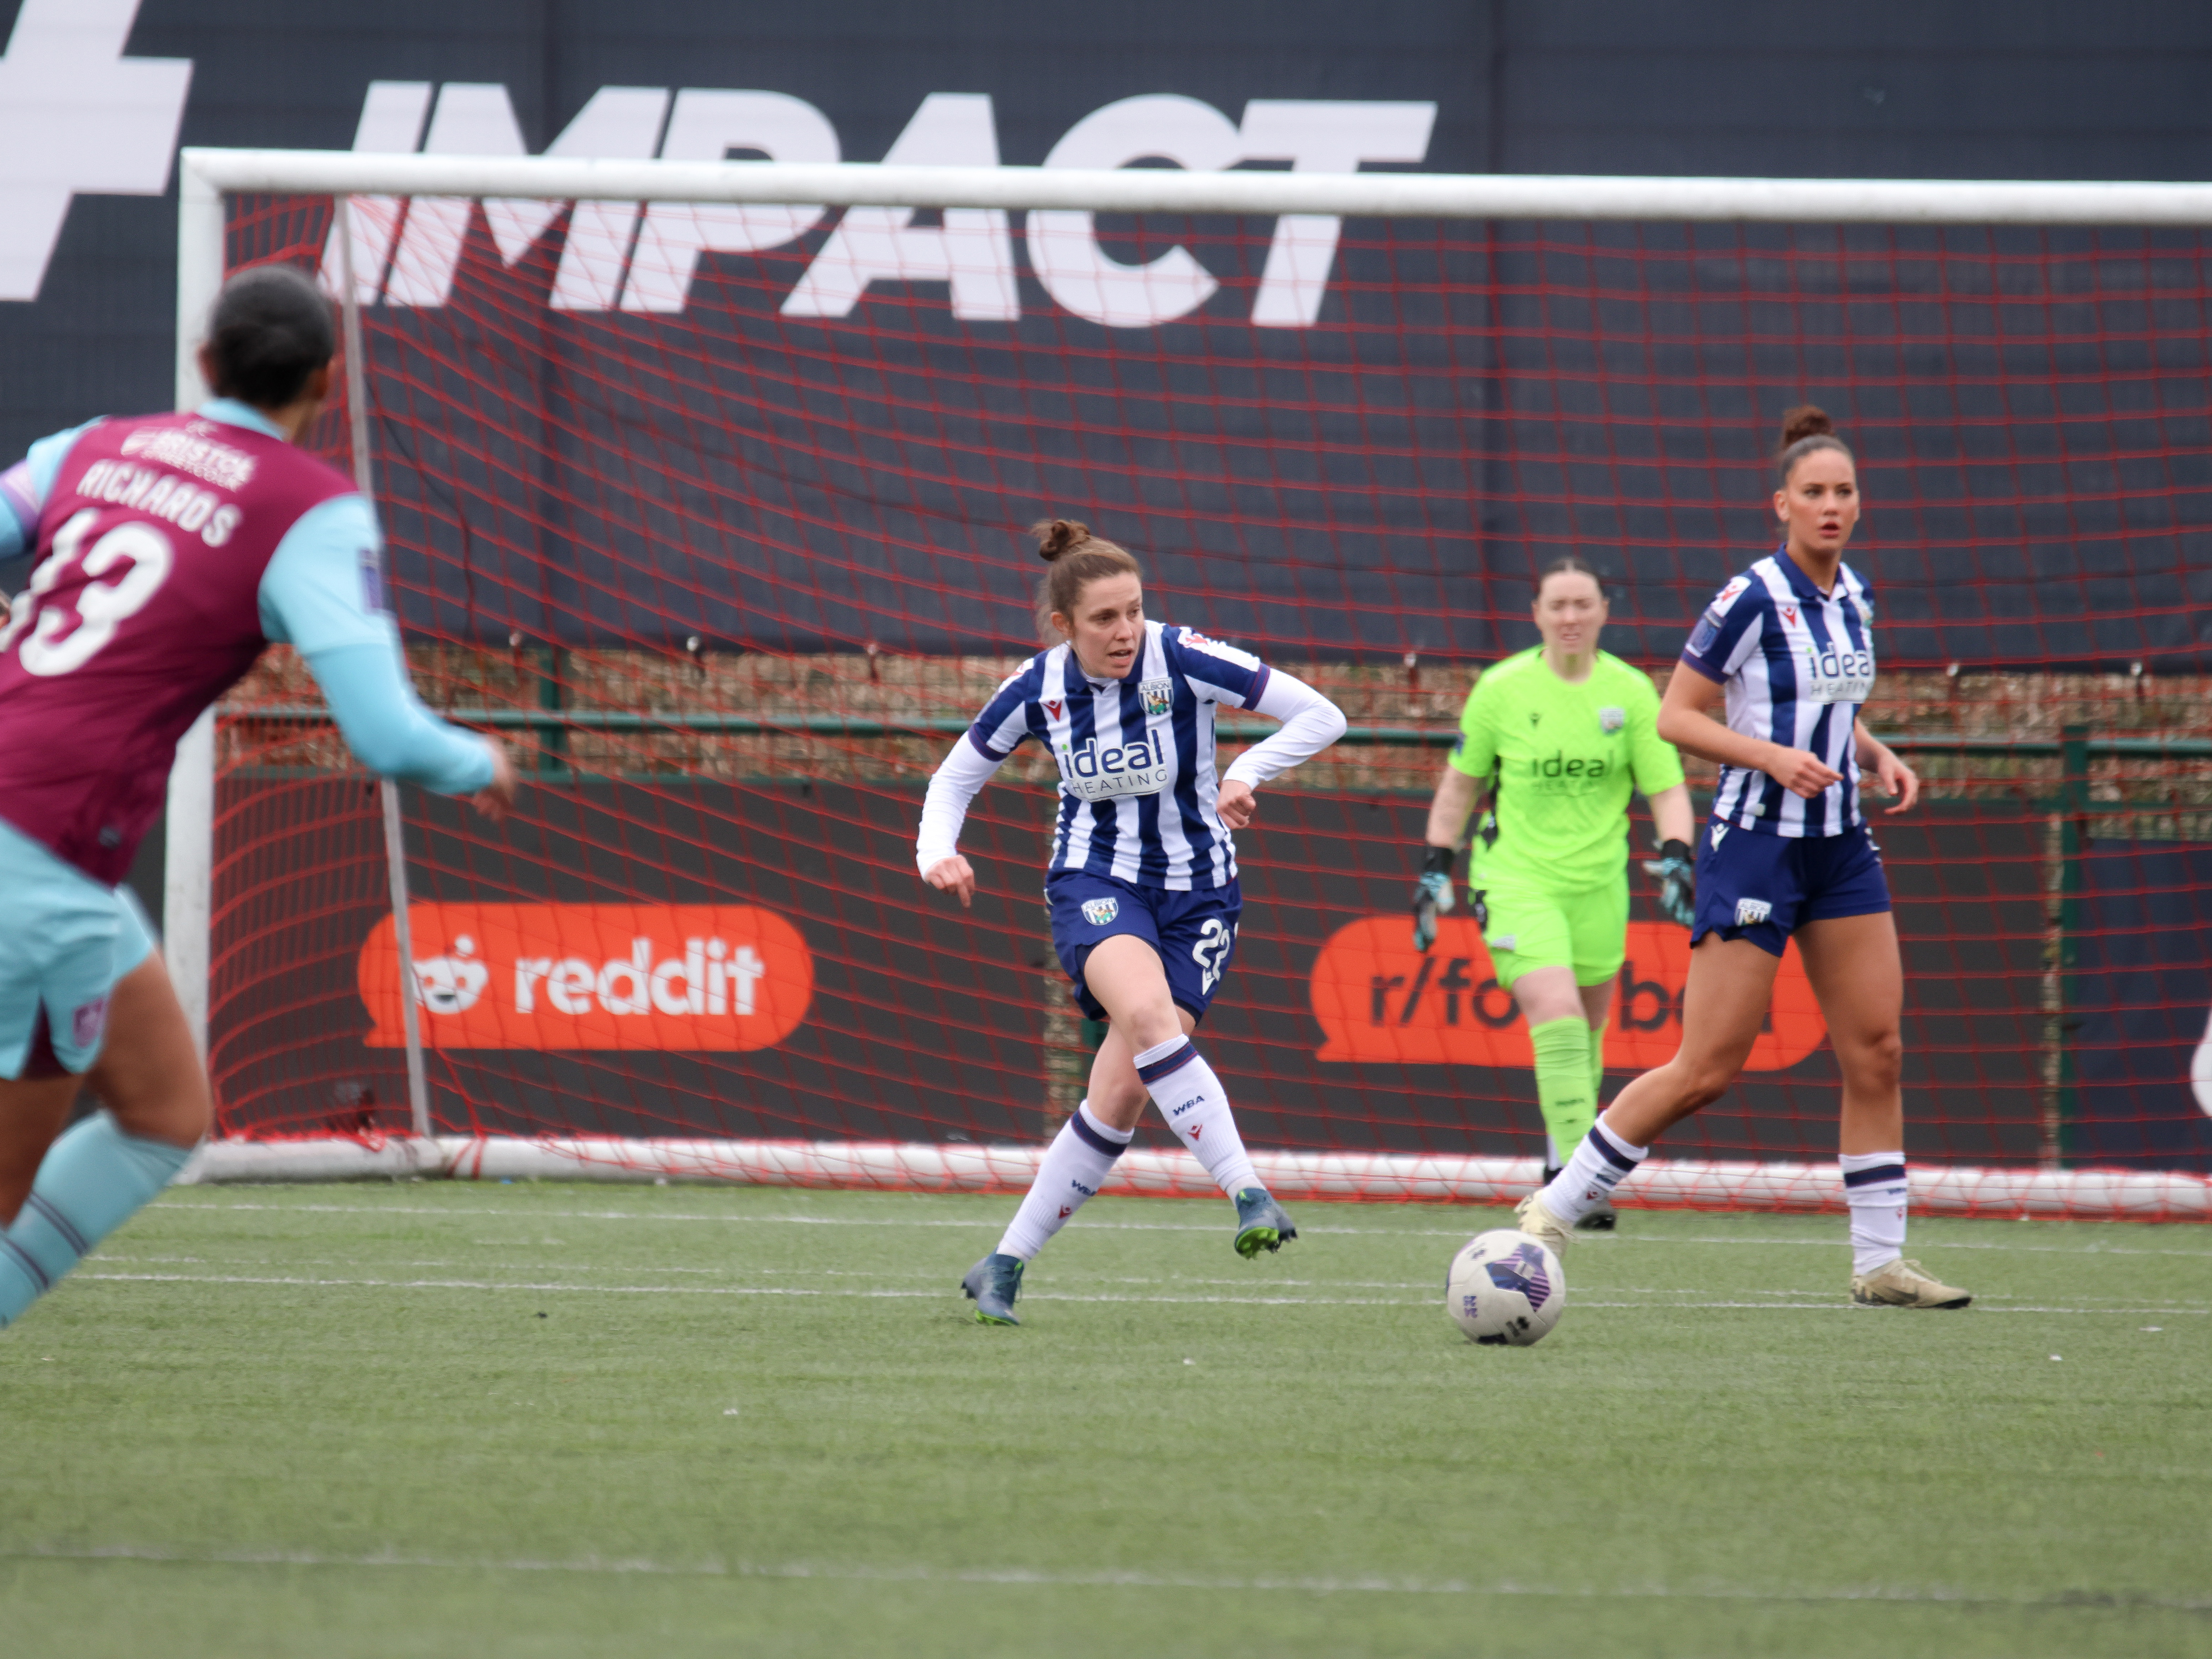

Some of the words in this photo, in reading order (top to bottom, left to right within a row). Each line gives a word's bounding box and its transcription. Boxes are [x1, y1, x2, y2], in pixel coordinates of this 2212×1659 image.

[317, 80, 1437, 329] IMPACT
[76, 459, 242, 547] RICHARDS
[0, 508, 174, 676] 13
[1806, 642, 1870, 678] idea
[1061, 729, 1164, 779] ideal
[1073, 769, 1167, 794] HEATING
[1532, 749, 1614, 778] ideal
[515, 936, 764, 1015] reddit
[1192, 918, 1230, 981] 22
[1173, 1096, 1204, 1116] WBA
